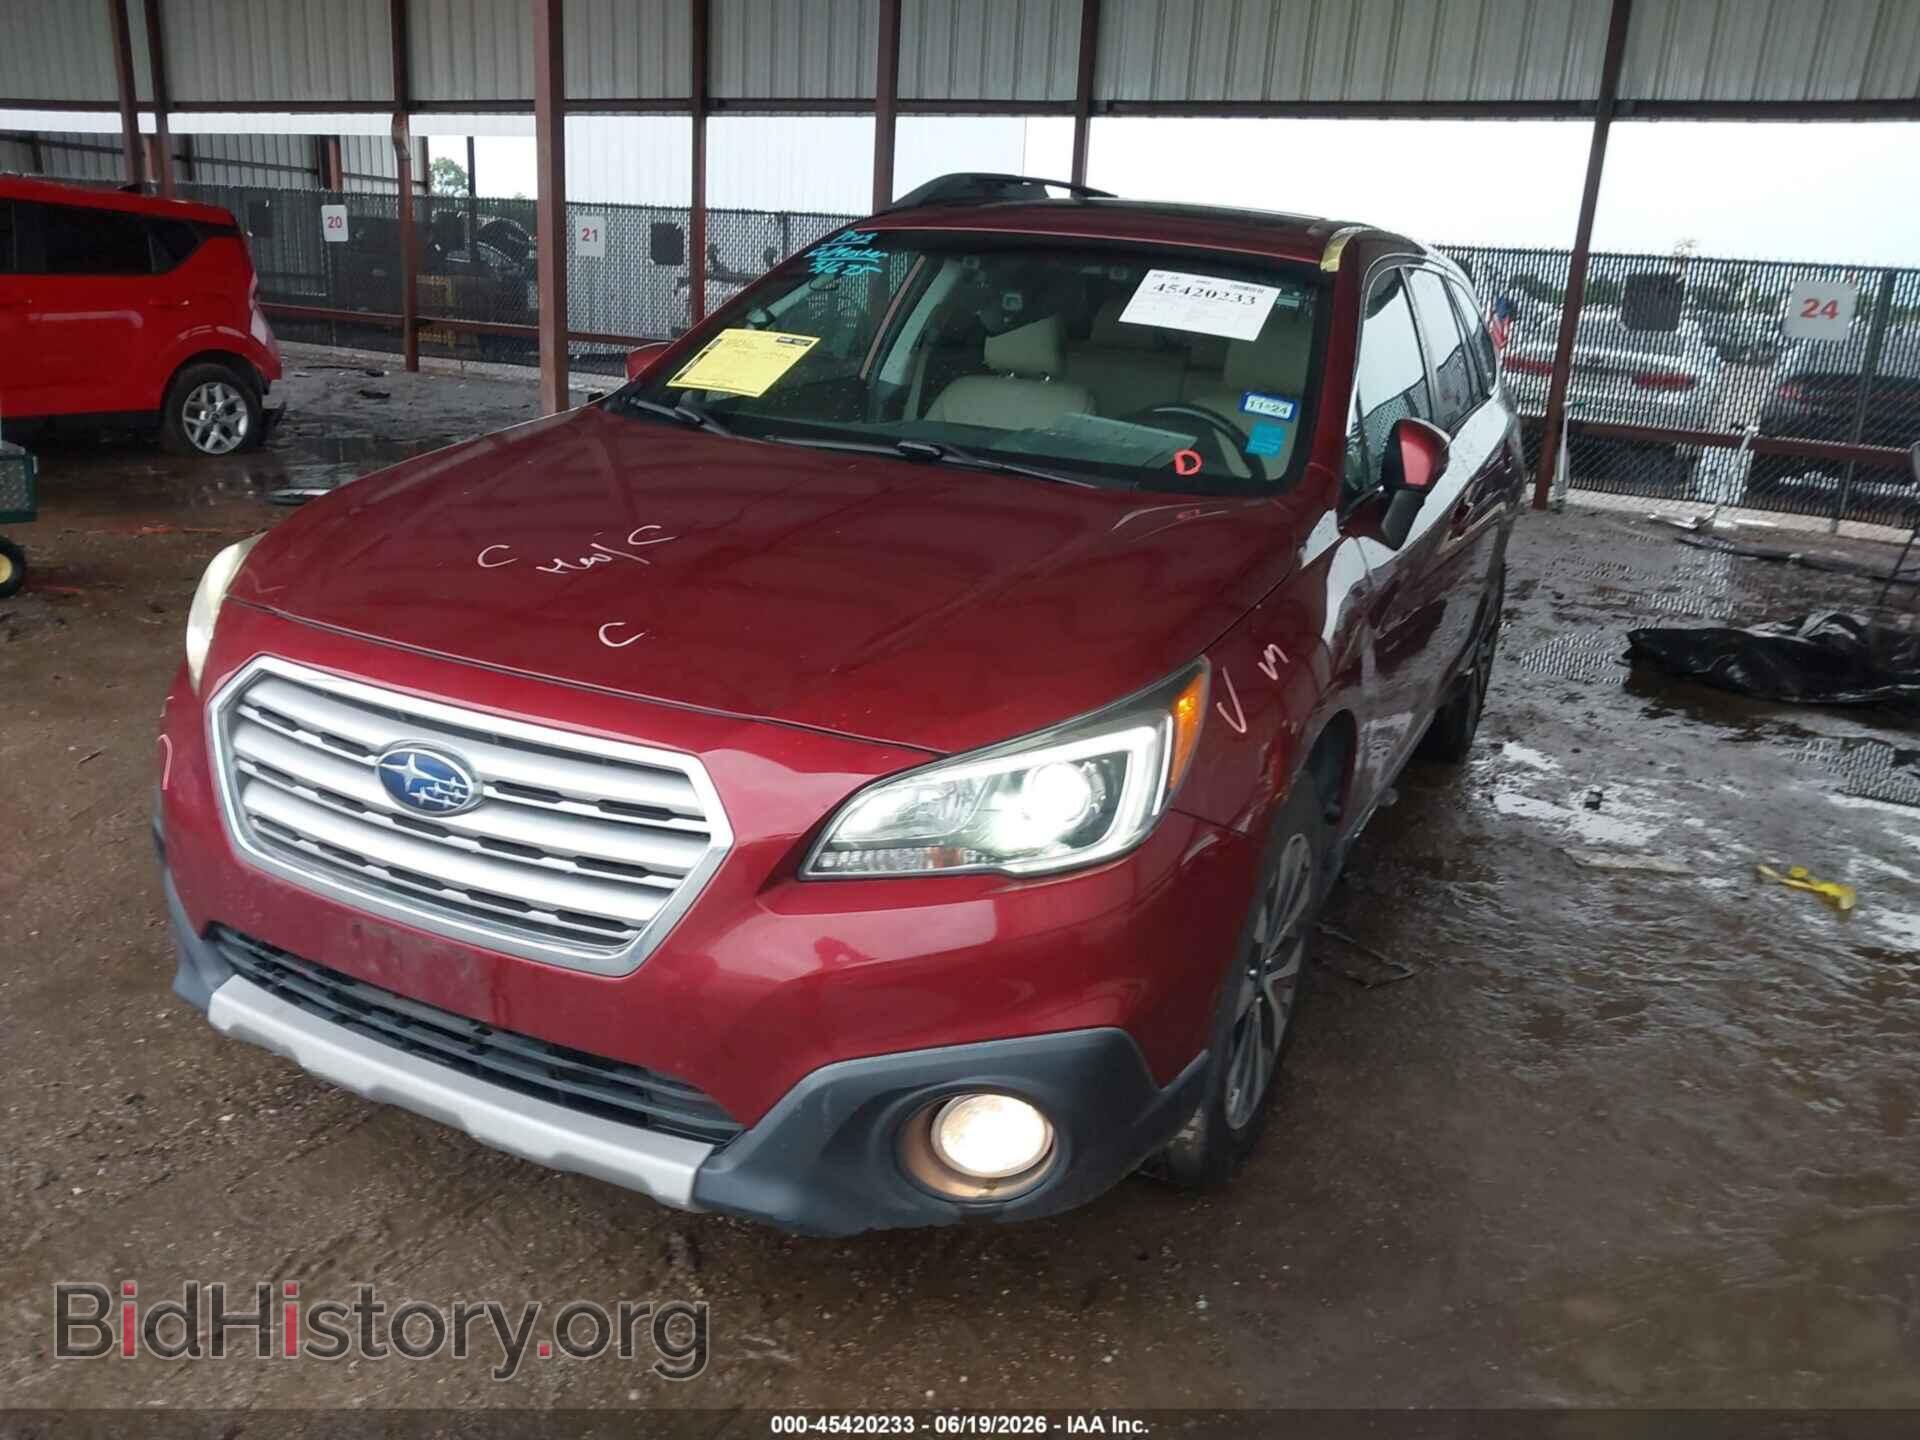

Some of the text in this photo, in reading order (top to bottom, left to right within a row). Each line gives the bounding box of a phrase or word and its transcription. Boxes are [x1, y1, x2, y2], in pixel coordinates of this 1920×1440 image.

[327, 215, 343, 229] 20
[581, 227, 598, 242] 21
[1153, 282, 1256, 306] 45420233
[1801, 298, 1839, 319] 24
[1175, 449, 1202, 475] D
